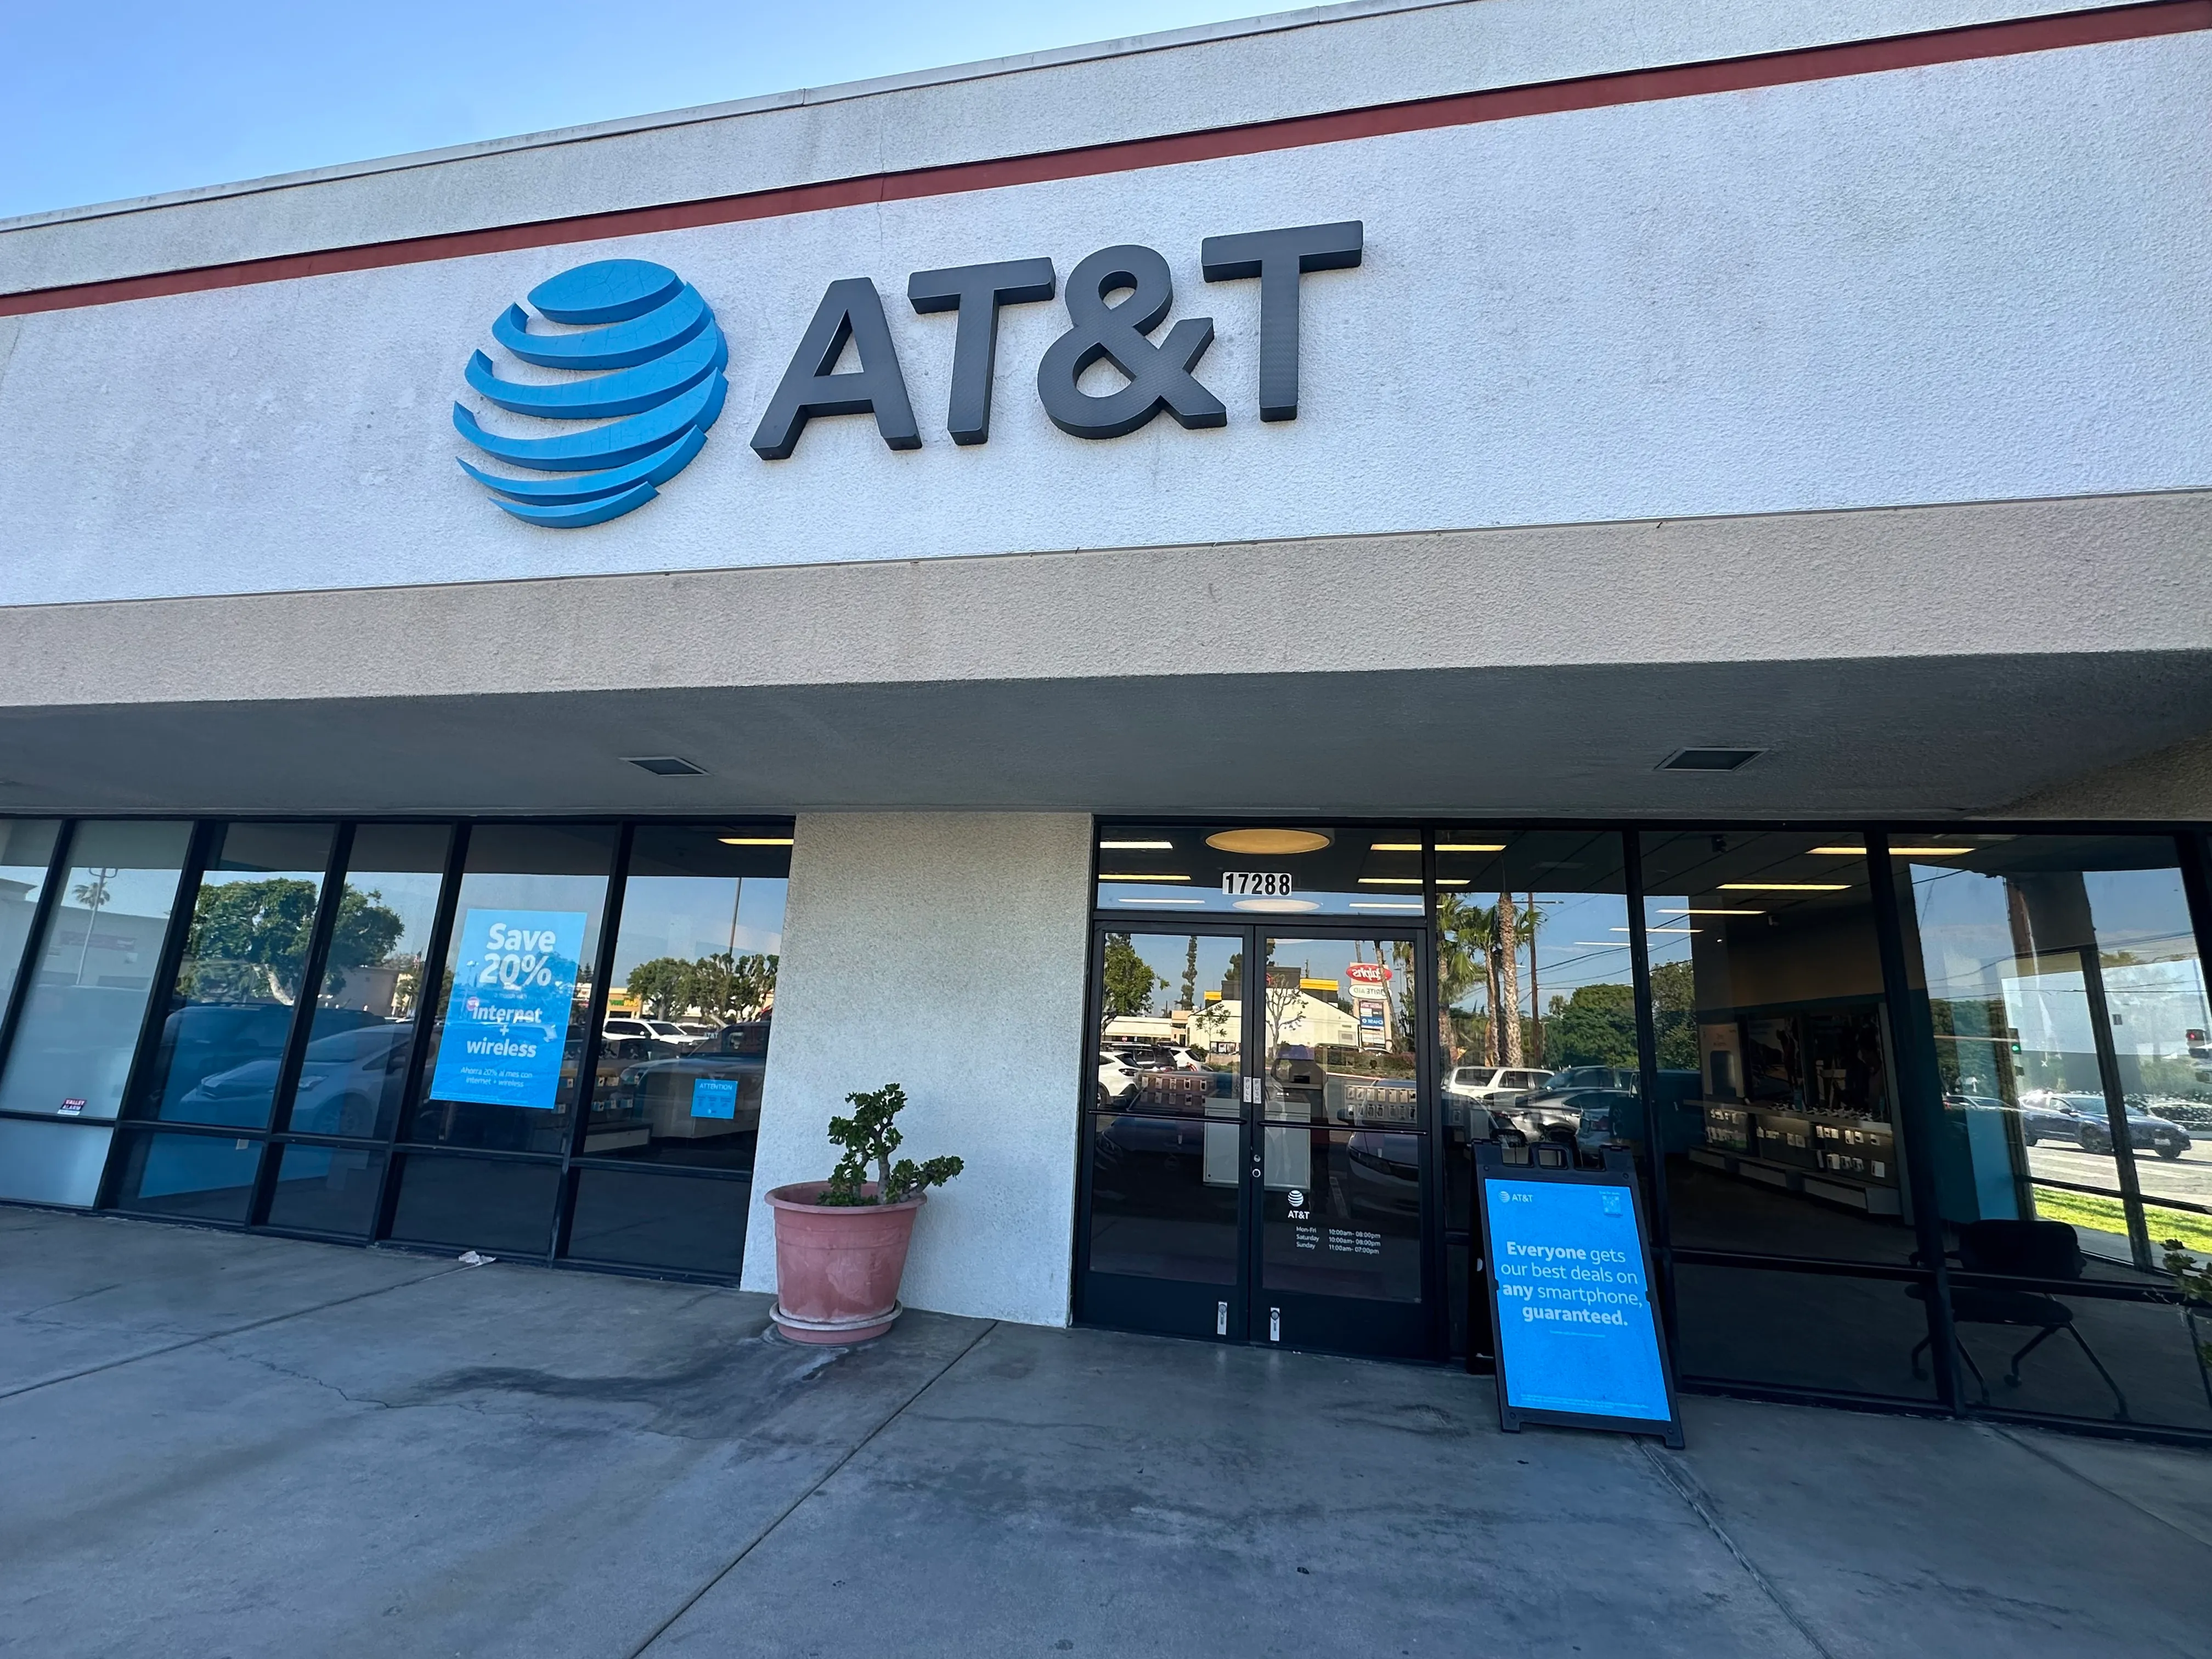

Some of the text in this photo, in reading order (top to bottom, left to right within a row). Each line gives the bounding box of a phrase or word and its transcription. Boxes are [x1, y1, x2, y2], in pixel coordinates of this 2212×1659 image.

[749, 220, 1364, 460] AT&T
[1226, 873, 1289, 895] 17288
[486, 923, 556, 952] Save
[479, 953, 552, 986] 20%
[472, 1005, 543, 1023] internet
[467, 1036, 537, 1058] wireless
[460, 1066, 482, 1075] Ahorra
[466, 1076, 492, 1085] internet
[498, 1079, 524, 1087] wireless
[1512, 1194, 1533, 1203] AT&T
[1288, 1210, 1310, 1220] AT&T
[1296, 1234, 1319, 1242] Saturday
[1356, 1231, 1381, 1239] 08:00pm
[1296, 1242, 1316, 1250] Sunday
[1506, 1241, 1626, 1265] Everyone gets
[1501, 1262, 1638, 1285] our best deals on
[1503, 1284, 1643, 1308] any smartphone,
[1522, 1306, 1628, 1326] guaranteed.
